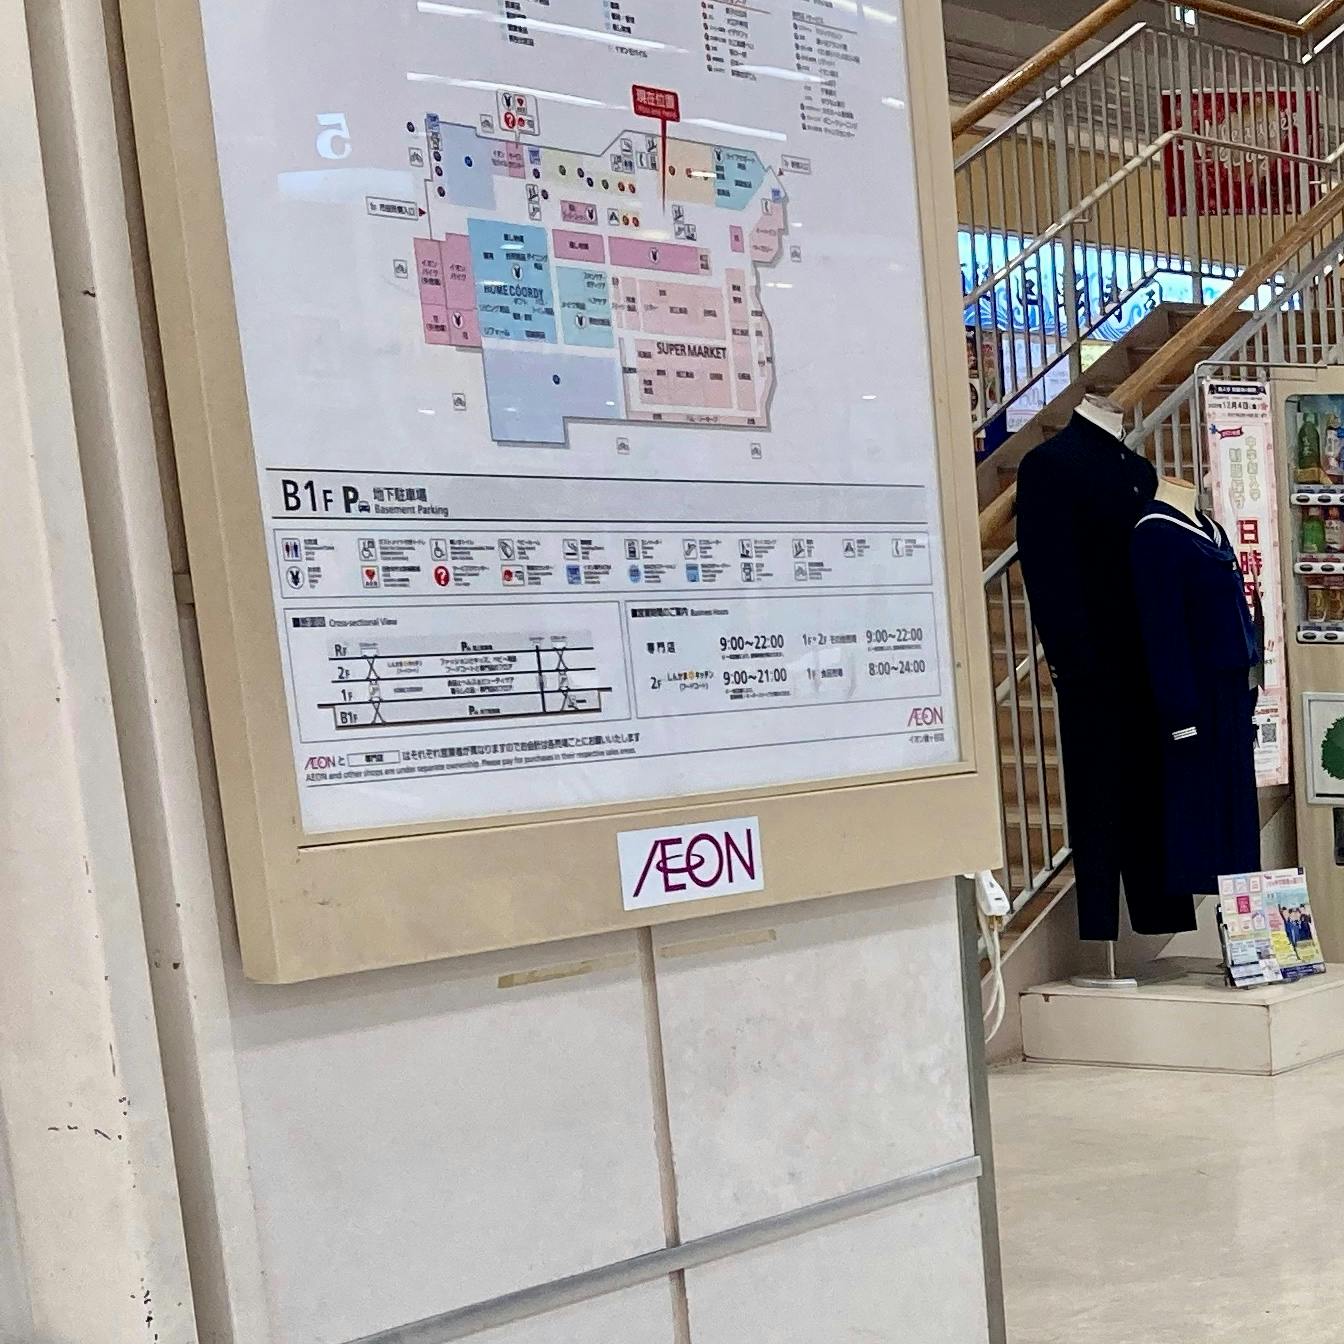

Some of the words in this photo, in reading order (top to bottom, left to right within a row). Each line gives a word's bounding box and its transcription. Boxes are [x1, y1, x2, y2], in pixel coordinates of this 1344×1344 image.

[656, 341, 686, 357] SUPER
[688, 343, 727, 360] MARKET
[282, 478, 334, 512] B1F
[374, 504, 415, 515] Basement
[417, 504, 449, 517] Parking
